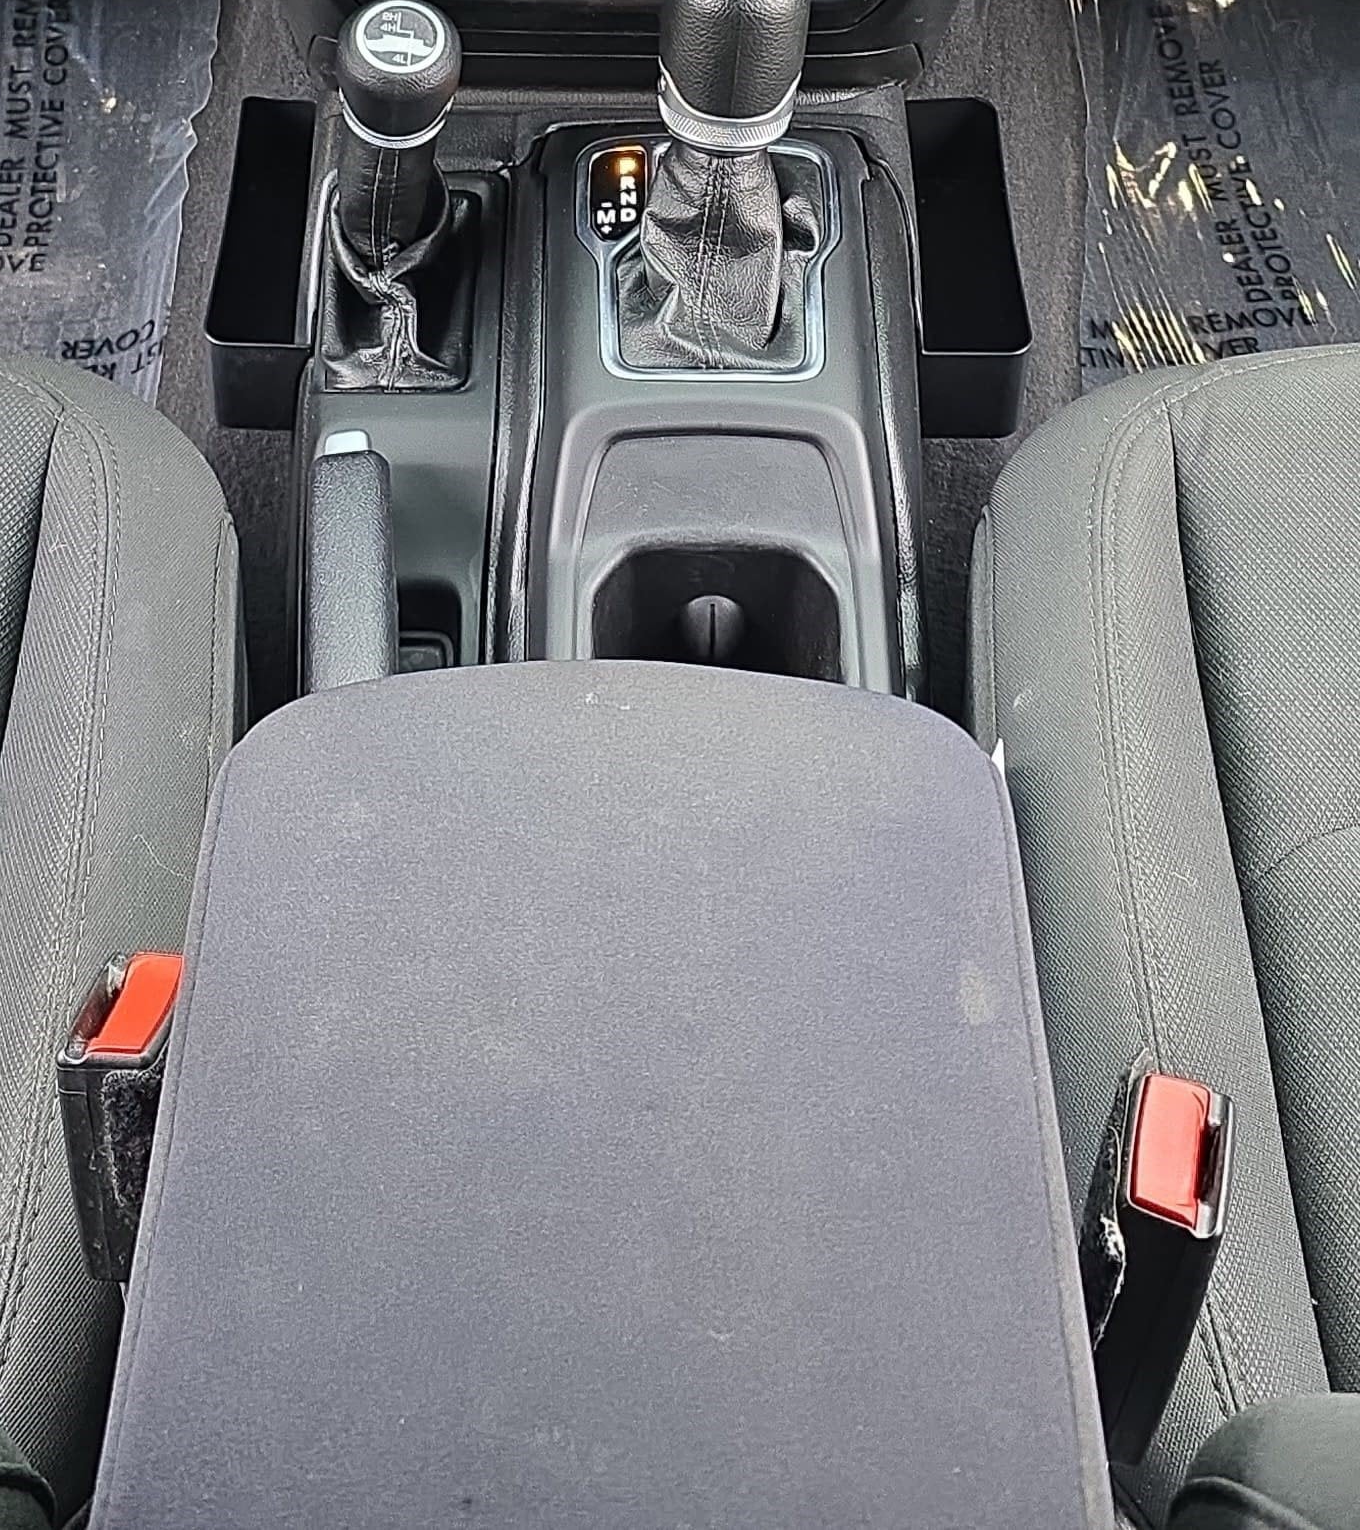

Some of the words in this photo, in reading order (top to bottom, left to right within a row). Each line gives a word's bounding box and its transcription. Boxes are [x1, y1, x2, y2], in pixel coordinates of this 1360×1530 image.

[380, 22, 397, 33] 4H
[392, 53, 407, 64] 4L
[1149, 3, 1201, 117] REMOVE
[3, 64, 34, 141] MUST
[1198, 58, 1242, 151] COVER
[23, 98, 66, 248] PROTECTIVE
[619, 174, 636, 191] R
[1181, 132, 1229, 203] MUST
[596, 208, 617, 225] M
[619, 191, 638, 206] N
[619, 207, 638, 223] D
[1214, 219, 1273, 303] DEALER
[60, 318, 156, 360] COVER
